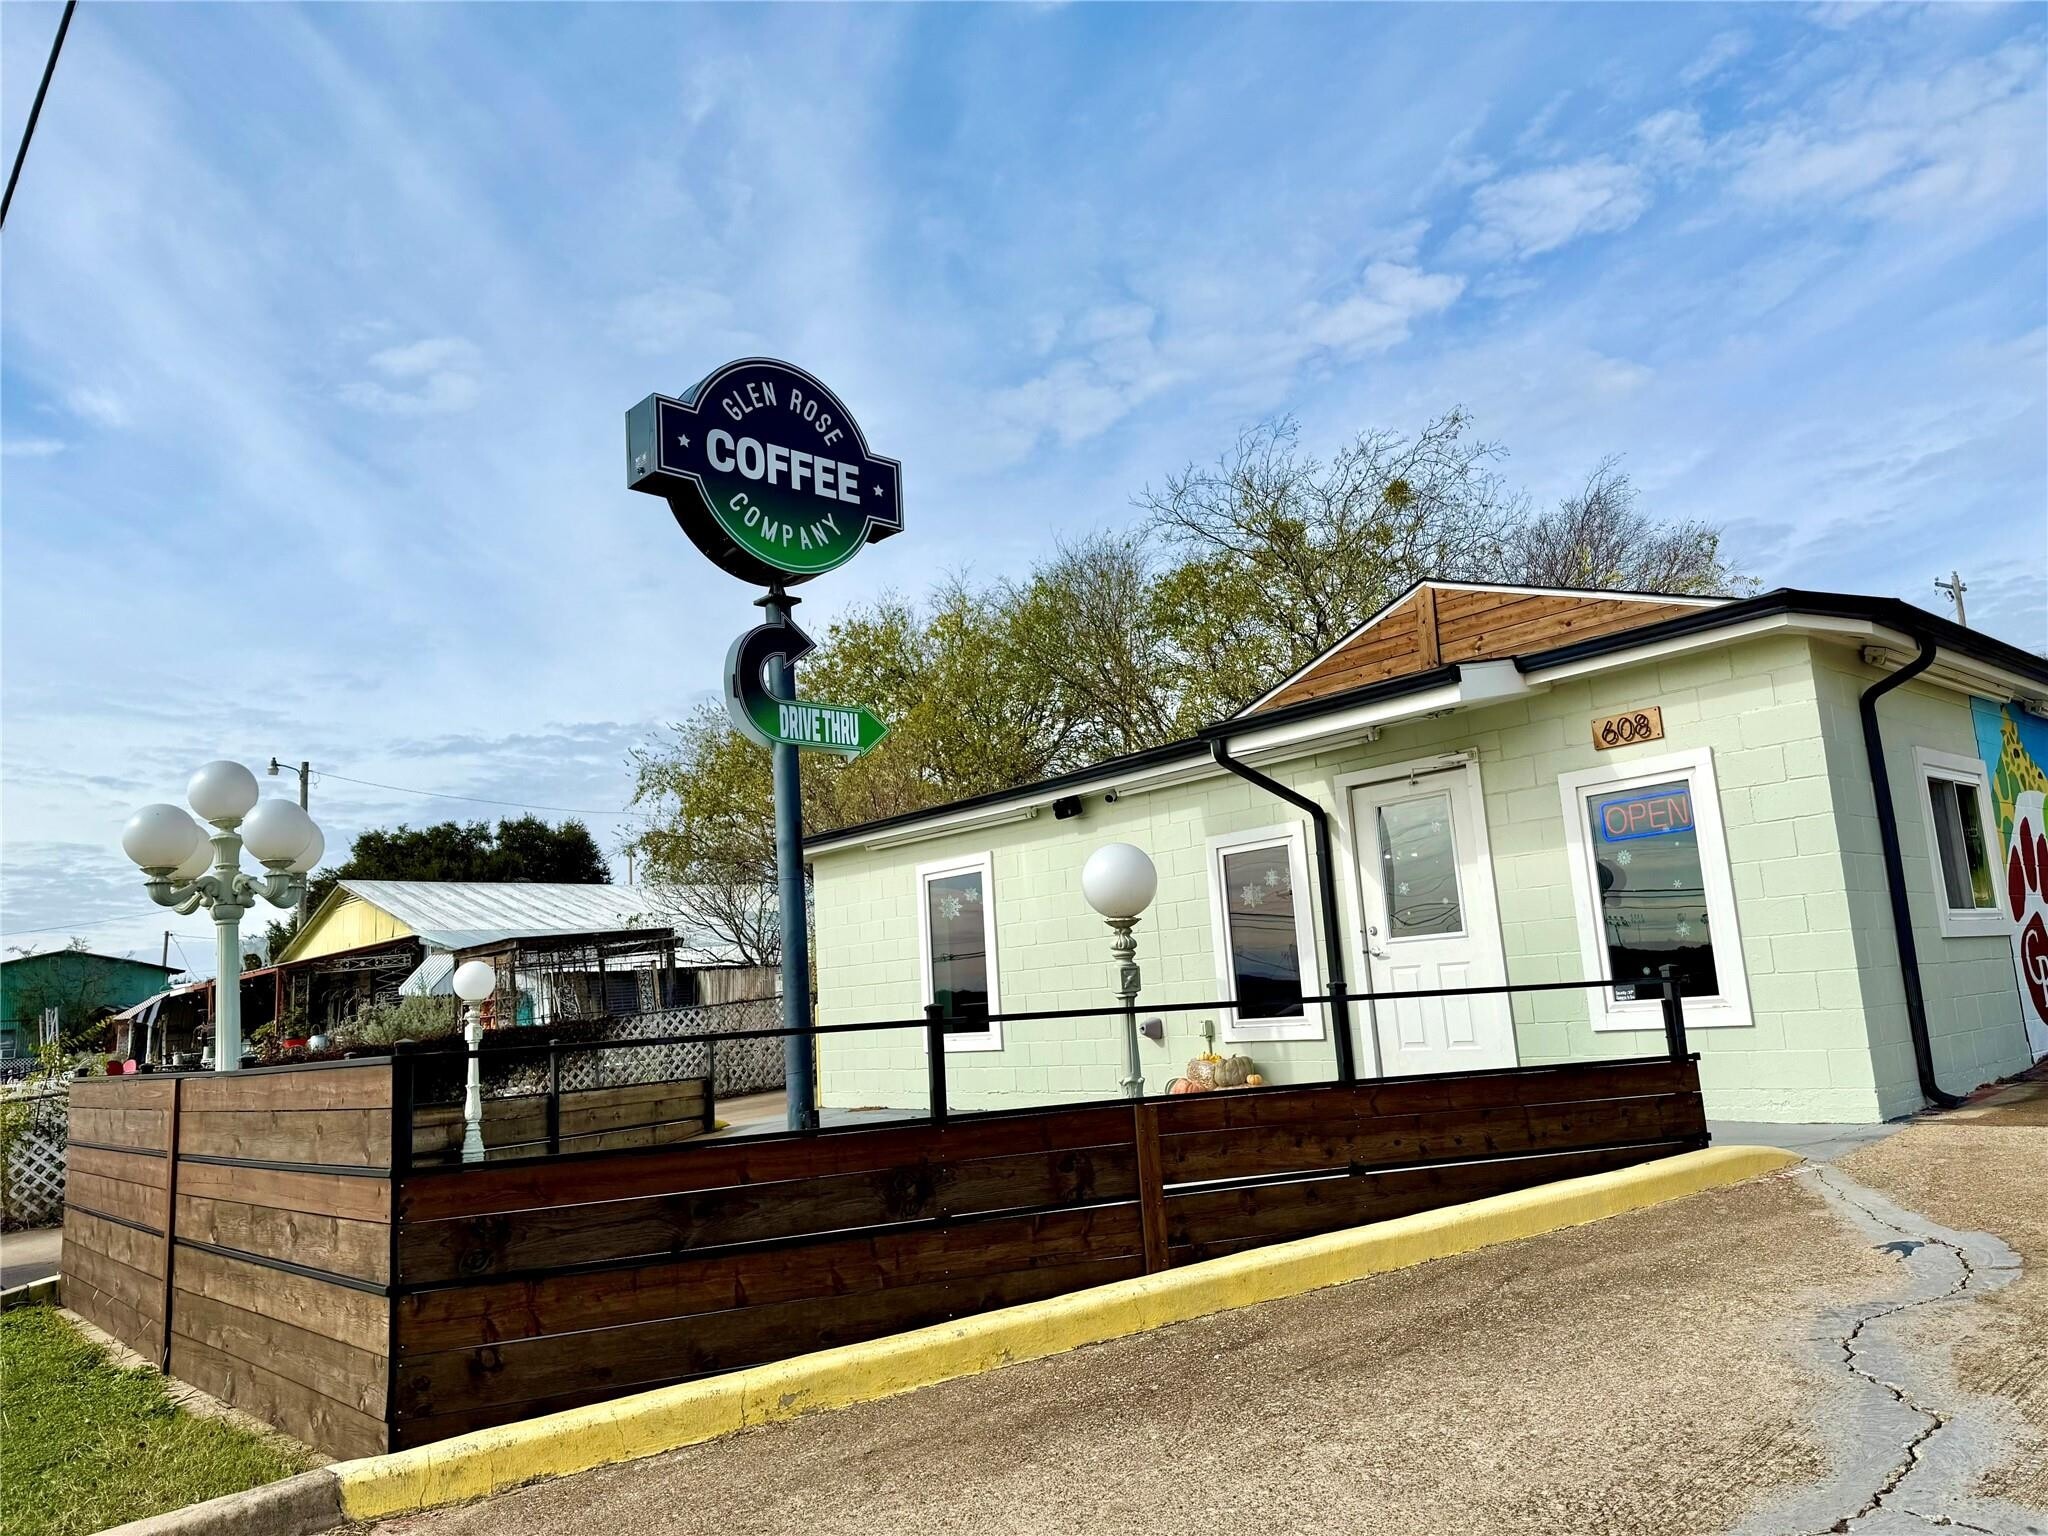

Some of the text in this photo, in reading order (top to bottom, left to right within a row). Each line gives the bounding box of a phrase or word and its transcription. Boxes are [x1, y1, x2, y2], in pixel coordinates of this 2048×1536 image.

[722, 381, 844, 446] GLEN ROSE
[706, 428, 860, 505] COFFEE
[729, 492, 841, 550] COMPANY
[778, 704, 859, 746] DRIVE THRU
[1602, 713, 1652, 745] 608
[1605, 796, 1690, 834] OPEN
